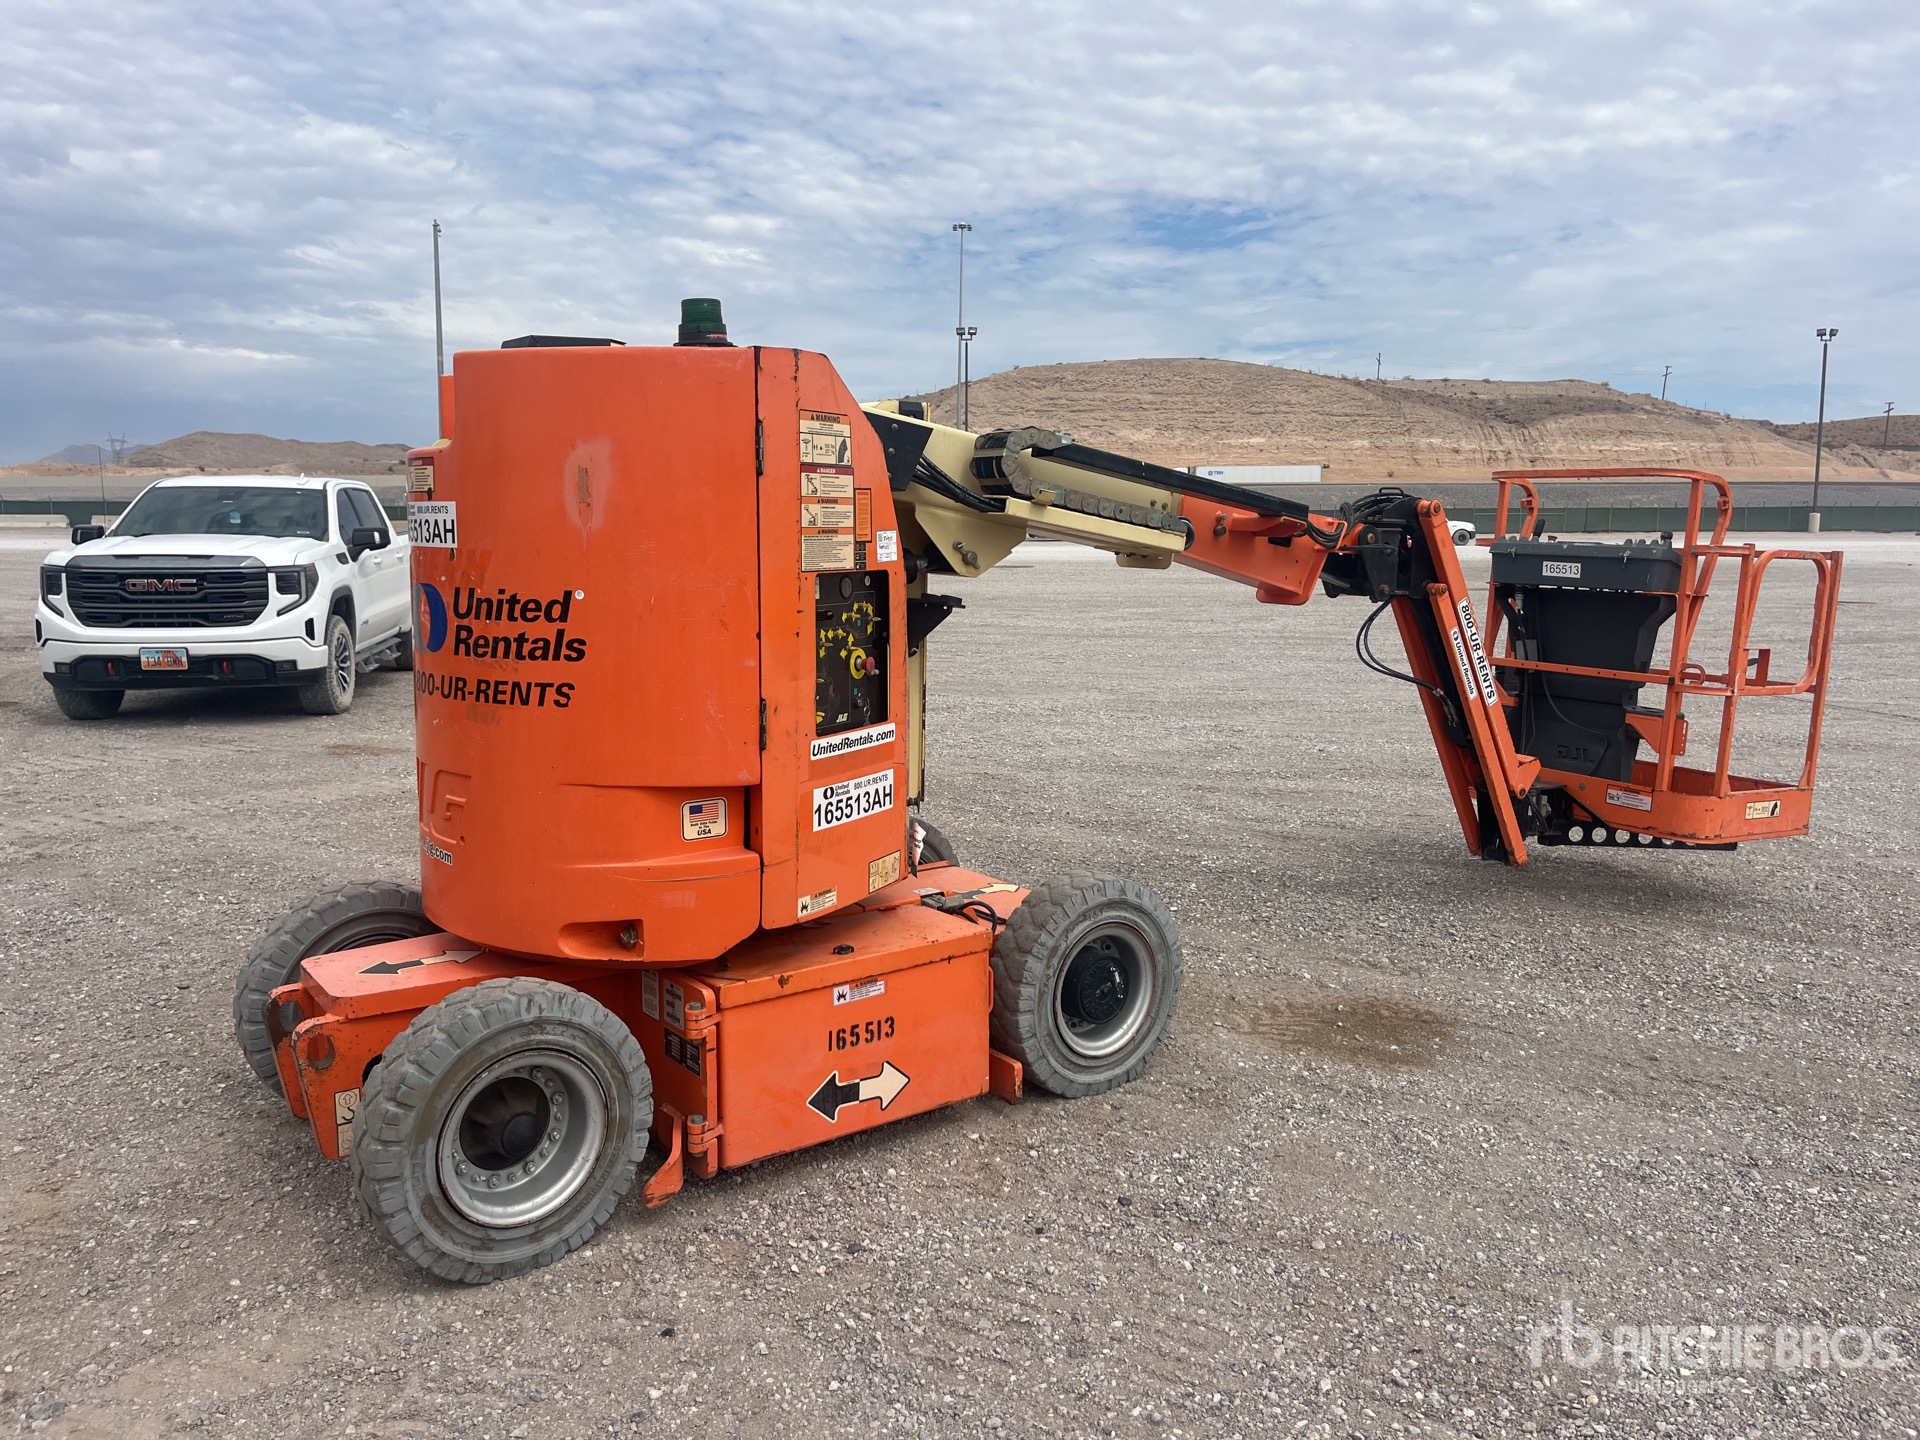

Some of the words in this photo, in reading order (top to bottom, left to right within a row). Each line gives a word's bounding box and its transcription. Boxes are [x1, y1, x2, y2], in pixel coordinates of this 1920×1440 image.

[815, 413, 840, 423] WARNING
[125, 579, 197, 592] GMC
[1543, 563, 1580, 576] 165513
[452, 586, 573, 624] United
[453, 624, 587, 662] Rentals
[1461, 604, 1495, 699] 800-UR-RENTS
[1455, 641, 1467, 667] United
[1463, 667, 1474, 695] Rentals
[416, 670, 576, 708] 800-UR-RENTS
[812, 729, 895, 757] UnitedRentals.com
[834, 782, 850, 792] United
[853, 773, 889, 791] 800.UR.RENTS
[834, 788, 851, 798] Rentals
[814, 783, 893, 827] 165513AH
[697, 828, 712, 836] USA
[827, 1015, 896, 1052] 165513
